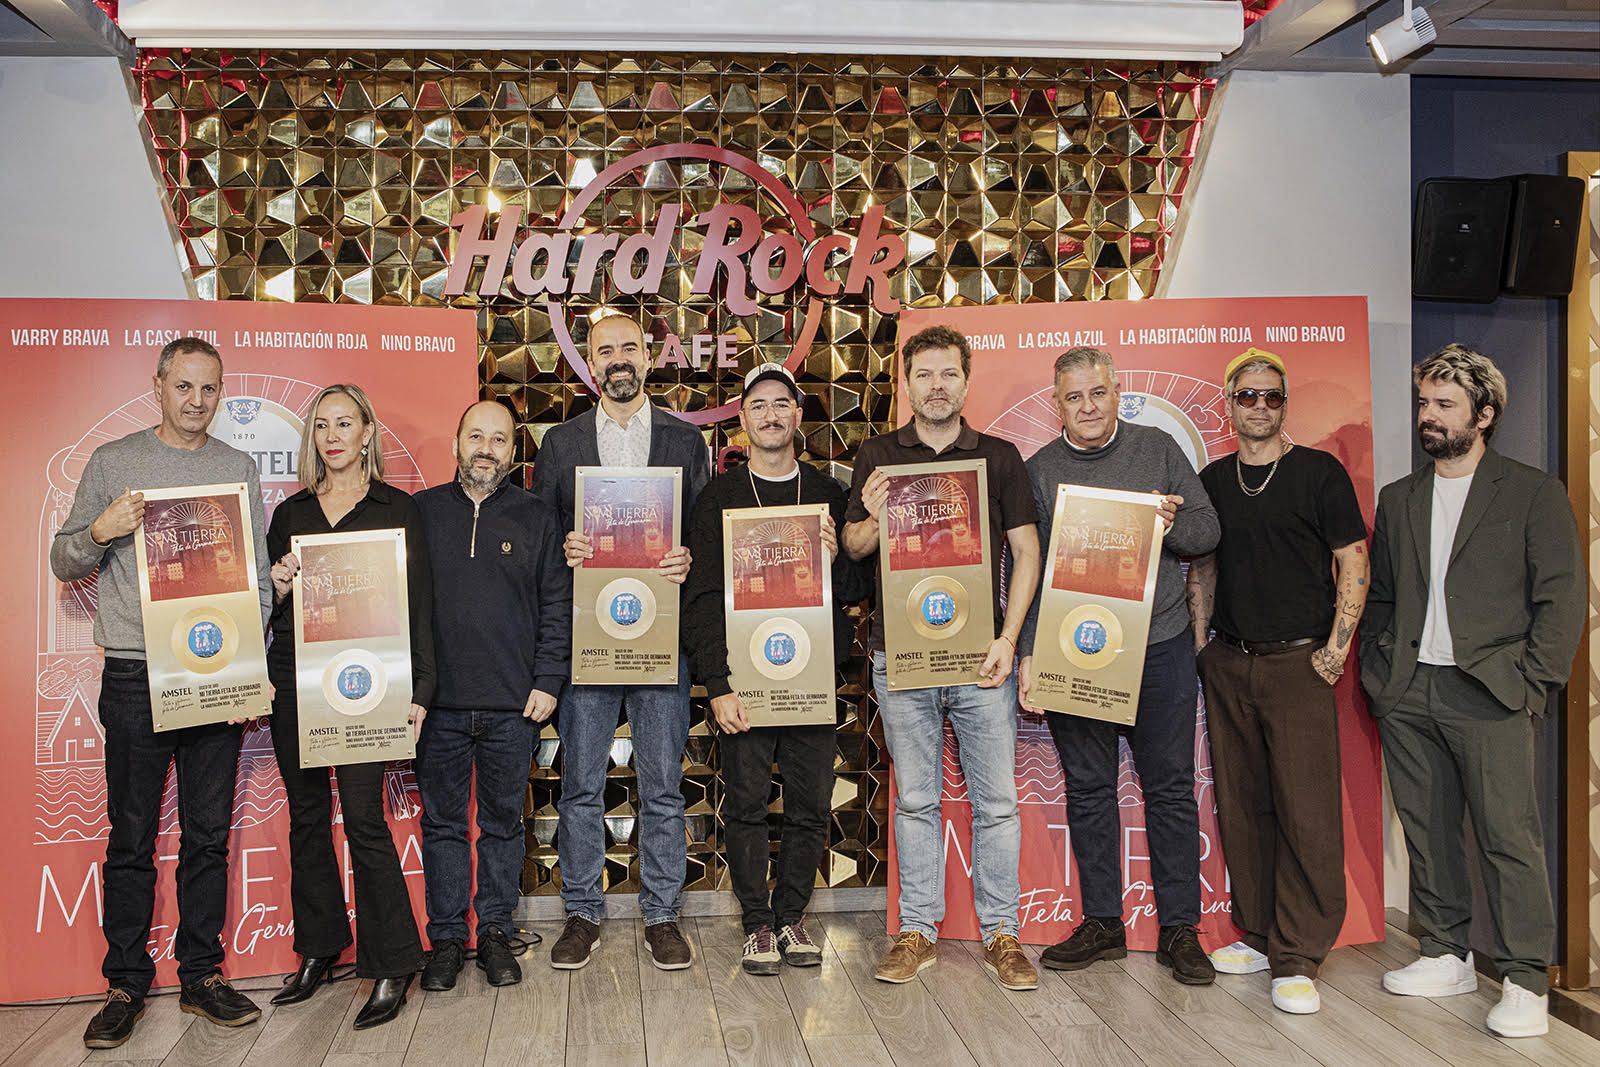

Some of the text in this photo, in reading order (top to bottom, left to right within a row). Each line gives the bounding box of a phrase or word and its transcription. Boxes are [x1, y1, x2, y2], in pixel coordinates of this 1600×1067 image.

[445, 202, 907, 317] Hard Rock
[11, 329, 110, 346] VARRY BRAVA
[124, 329, 142, 346] LA
[234, 330, 368, 350] LA HABITACIÓN ROJA
[1018, 330, 1107, 348] LA CASA AZUL
[1119, 325, 1252, 346] LA HABITACIÓN ROJA
[1265, 326, 1345, 343] NINO BRAVO
[381, 334, 456, 353] NINO BRAVO
[645, 333, 739, 368] AFE
[616, 507, 657, 519] TIERRA
[920, 503, 964, 516] TIERRA
[180, 527, 227, 542] TIERRA
[1093, 529, 1135, 547] TIERRA
[763, 546, 806, 559] TIERRA
[336, 574, 384, 587] TIERRA
[894, 651, 923, 660] AMSTEL
[1038, 672, 1067, 682] AMSTEL
[160, 687, 192, 698] AMSTEL
[205, 688, 220, 696] TIERRA
[308, 726, 338, 735] AMSTEL
[1019, 888, 1073, 928] Feta
